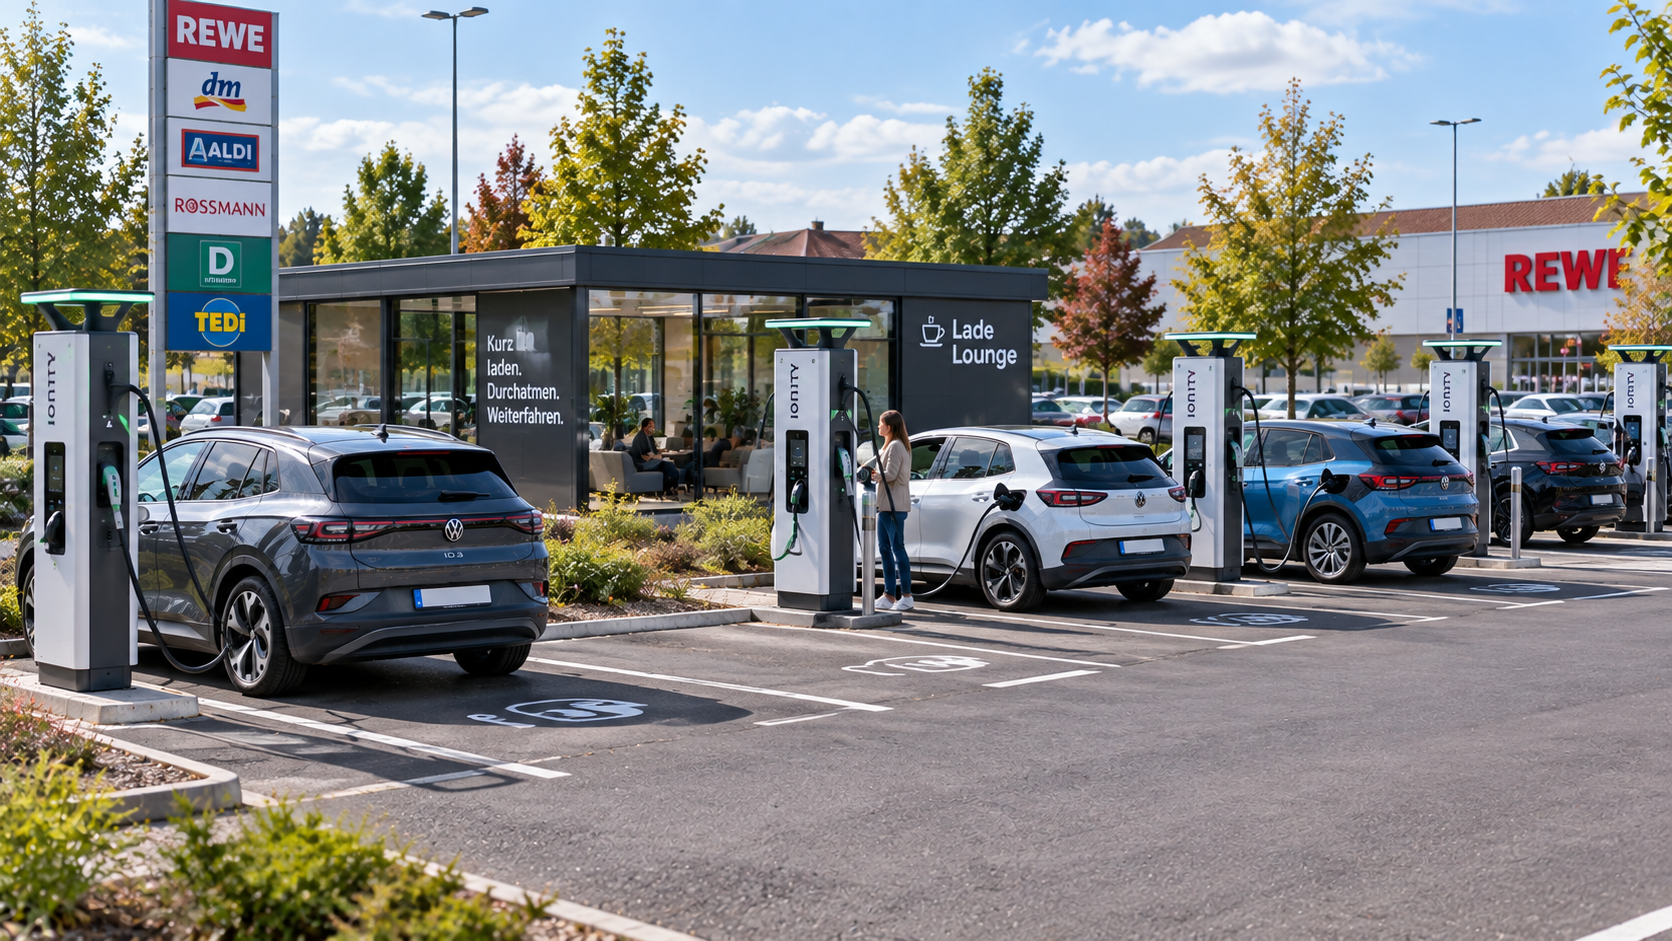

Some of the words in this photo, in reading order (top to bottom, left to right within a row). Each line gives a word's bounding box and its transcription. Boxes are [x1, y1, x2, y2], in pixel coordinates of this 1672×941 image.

[177, 15, 264, 53] REWE
[202, 72, 241, 98] dm
[174, 197, 266, 217] ROSSMANN
[208, 246, 235, 275] D
[194, 312, 246, 333] TEDi
[952, 319, 994, 340] Lade
[487, 335, 514, 352] Kurz
[487, 358, 522, 376] laden.
[952, 344, 1018, 370] Lounge
[487, 382, 560, 400] Durchatmen.
[486, 406, 564, 425] Weiterfahren.
